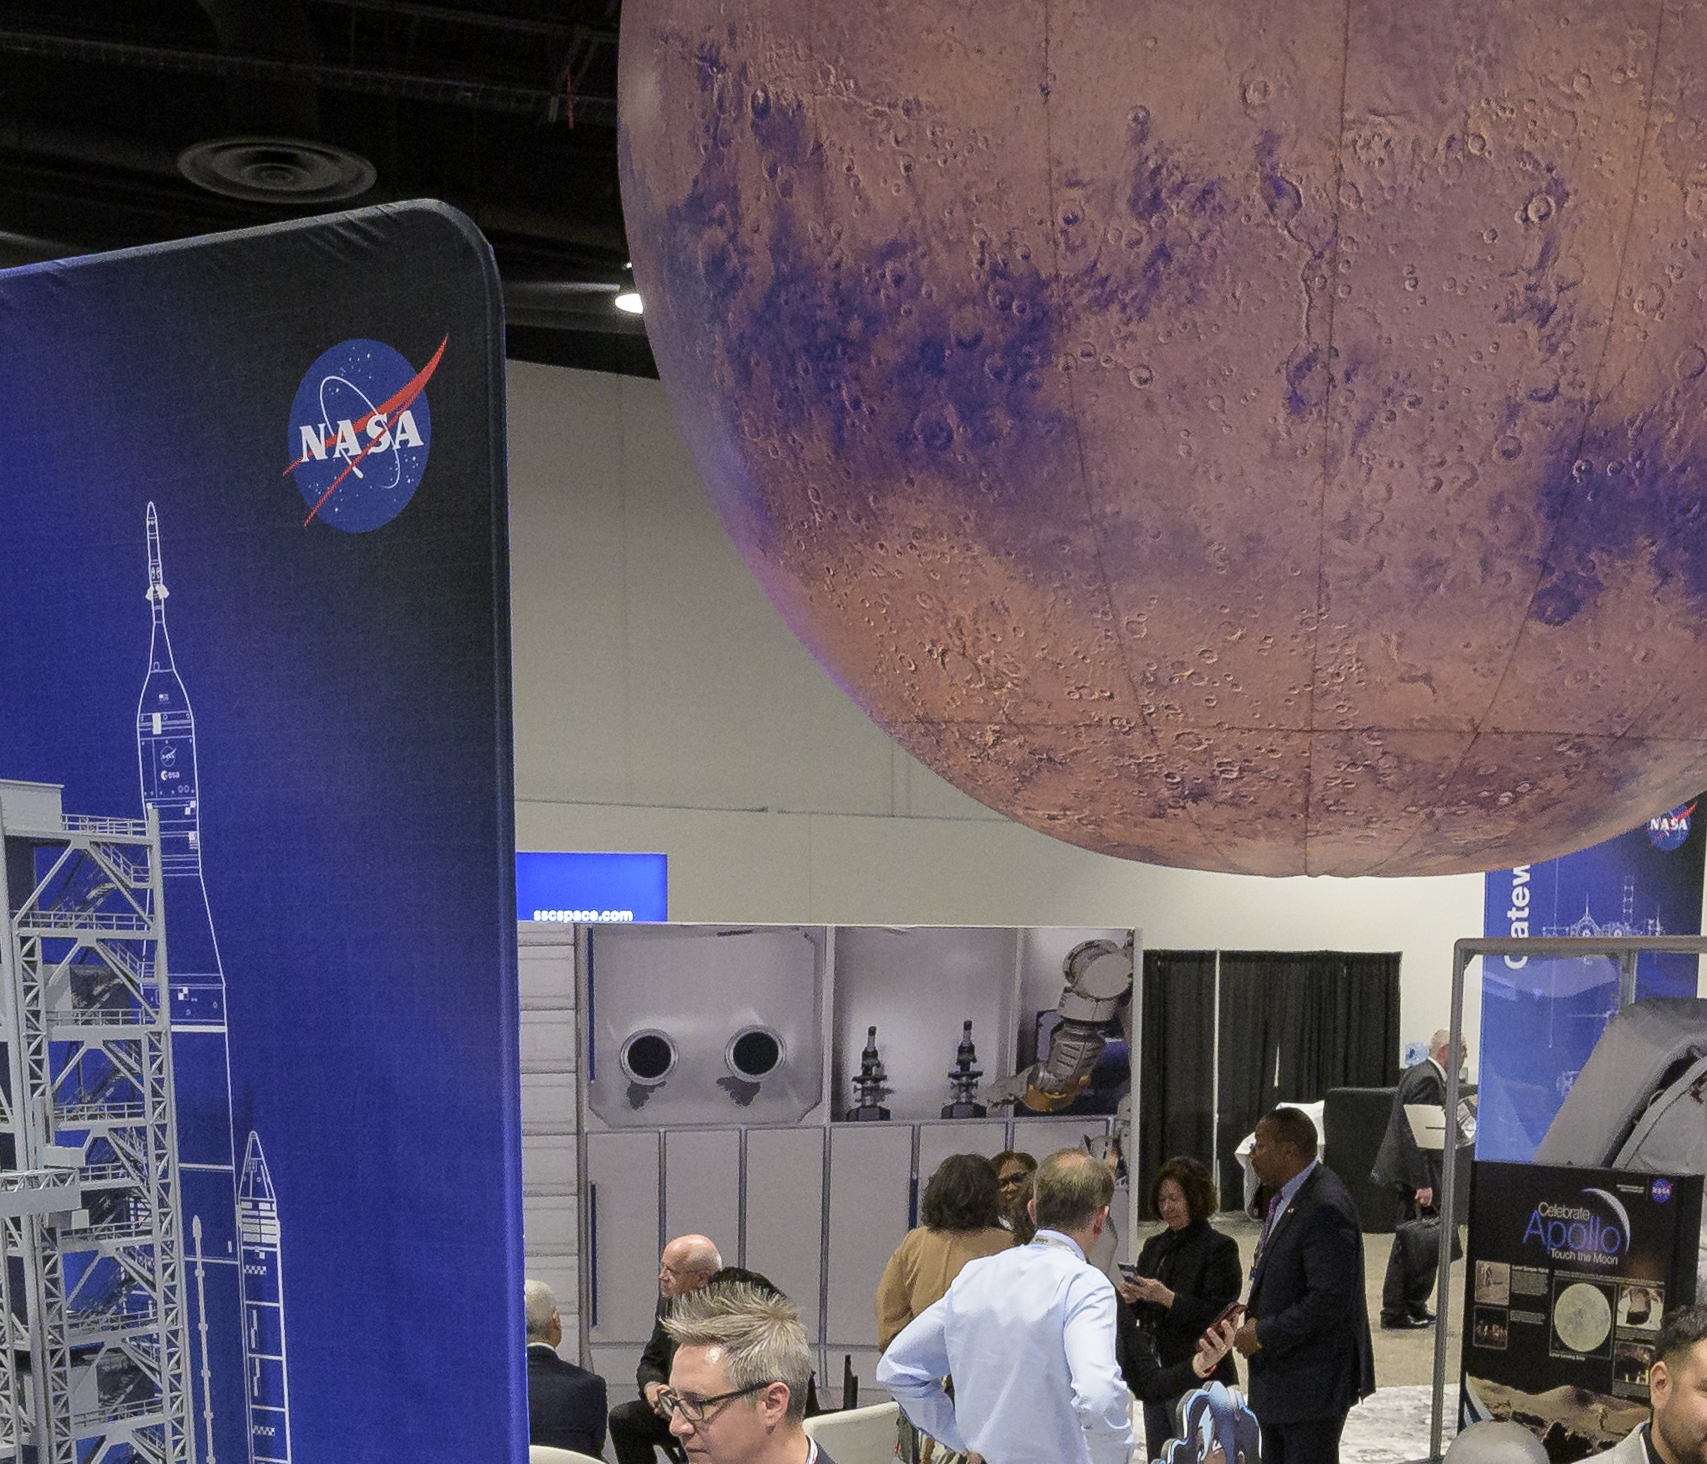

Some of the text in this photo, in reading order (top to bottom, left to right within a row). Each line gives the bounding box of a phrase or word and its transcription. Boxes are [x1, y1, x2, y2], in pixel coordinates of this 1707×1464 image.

[299, 410, 425, 463] NASA
[1650, 817, 1688, 831] NASA
[533, 910, 634, 923] sscspace.com
[1538, 1202, 1590, 1221] Celebrate
[1522, 1210, 1621, 1254] Apollo
[1551, 1248, 1619, 1266] Touch the Moon
